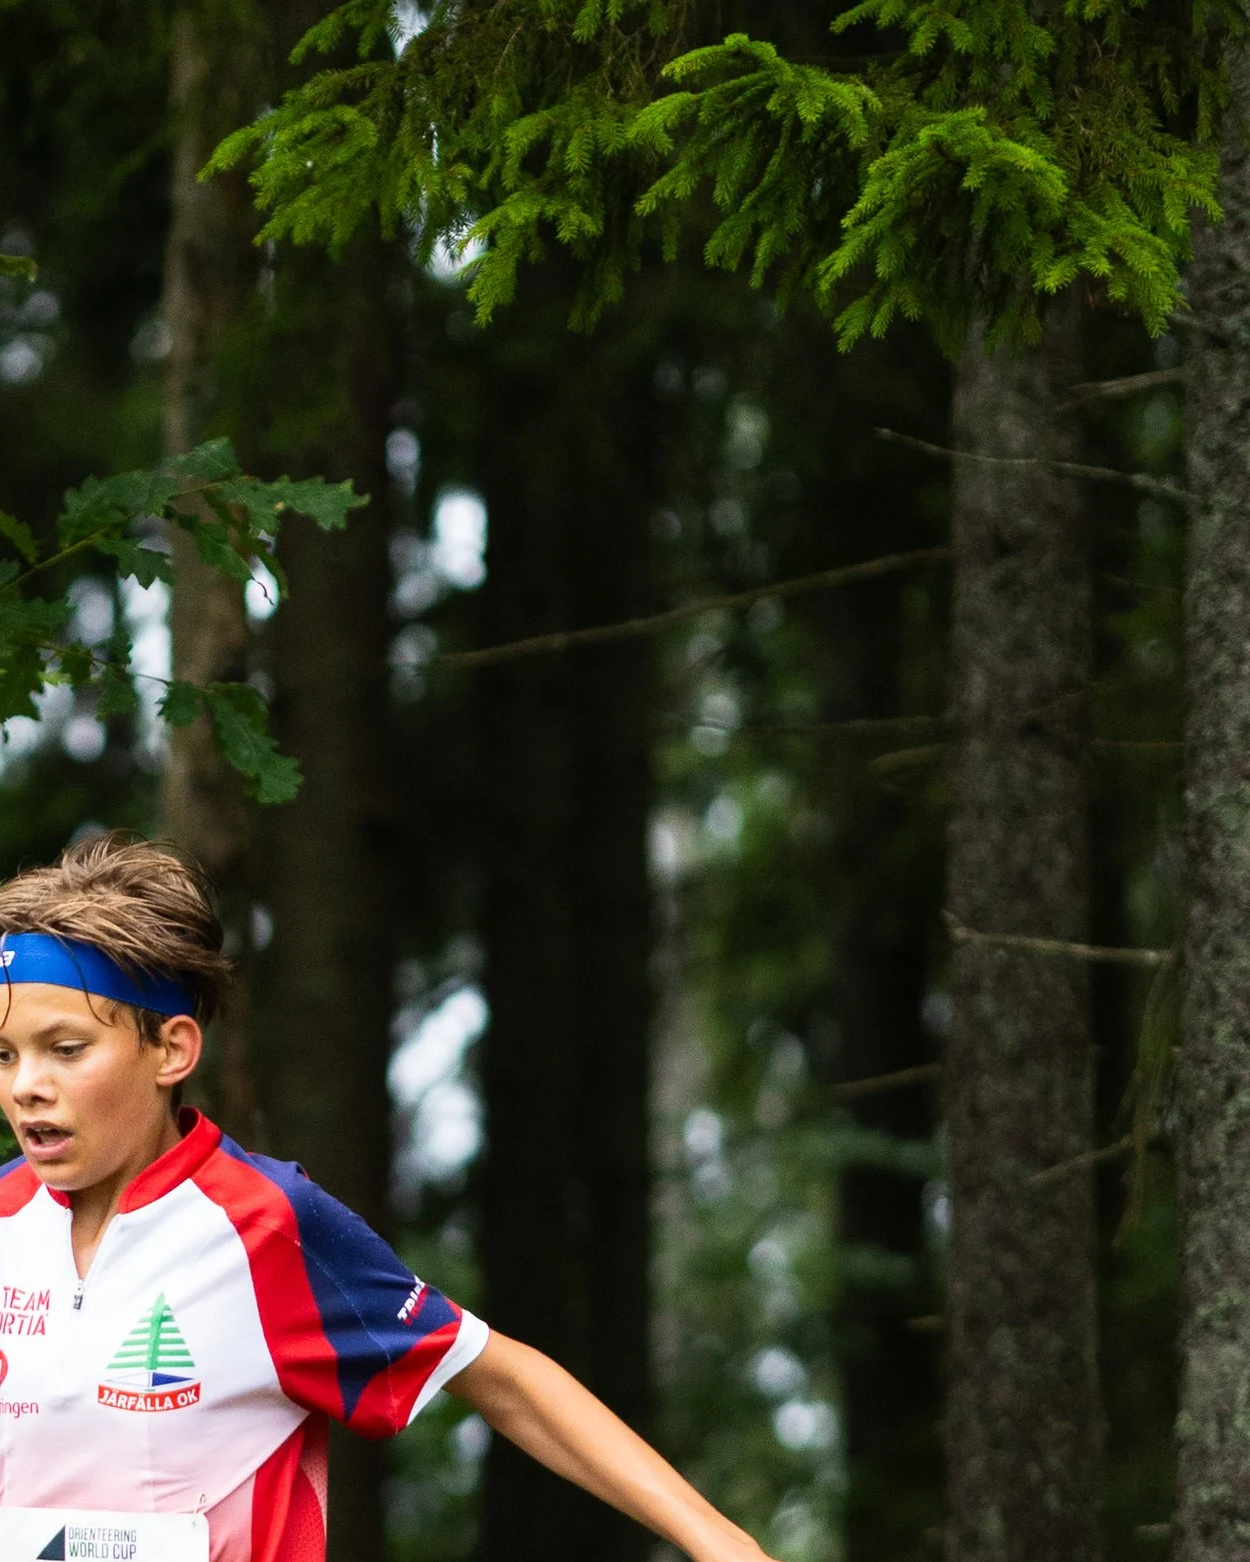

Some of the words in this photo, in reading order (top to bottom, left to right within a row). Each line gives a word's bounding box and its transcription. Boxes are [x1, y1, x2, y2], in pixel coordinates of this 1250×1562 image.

[3, 1286, 50, 1311] TEAM
[100, 1388, 174, 1411] JÄRFÄLLA
[177, 1389, 198, 1406] OK
[69, 1526, 137, 1543] ORIENTEERING
[69, 1541, 109, 1559] WORLD
[113, 1543, 137, 1561] CUP
